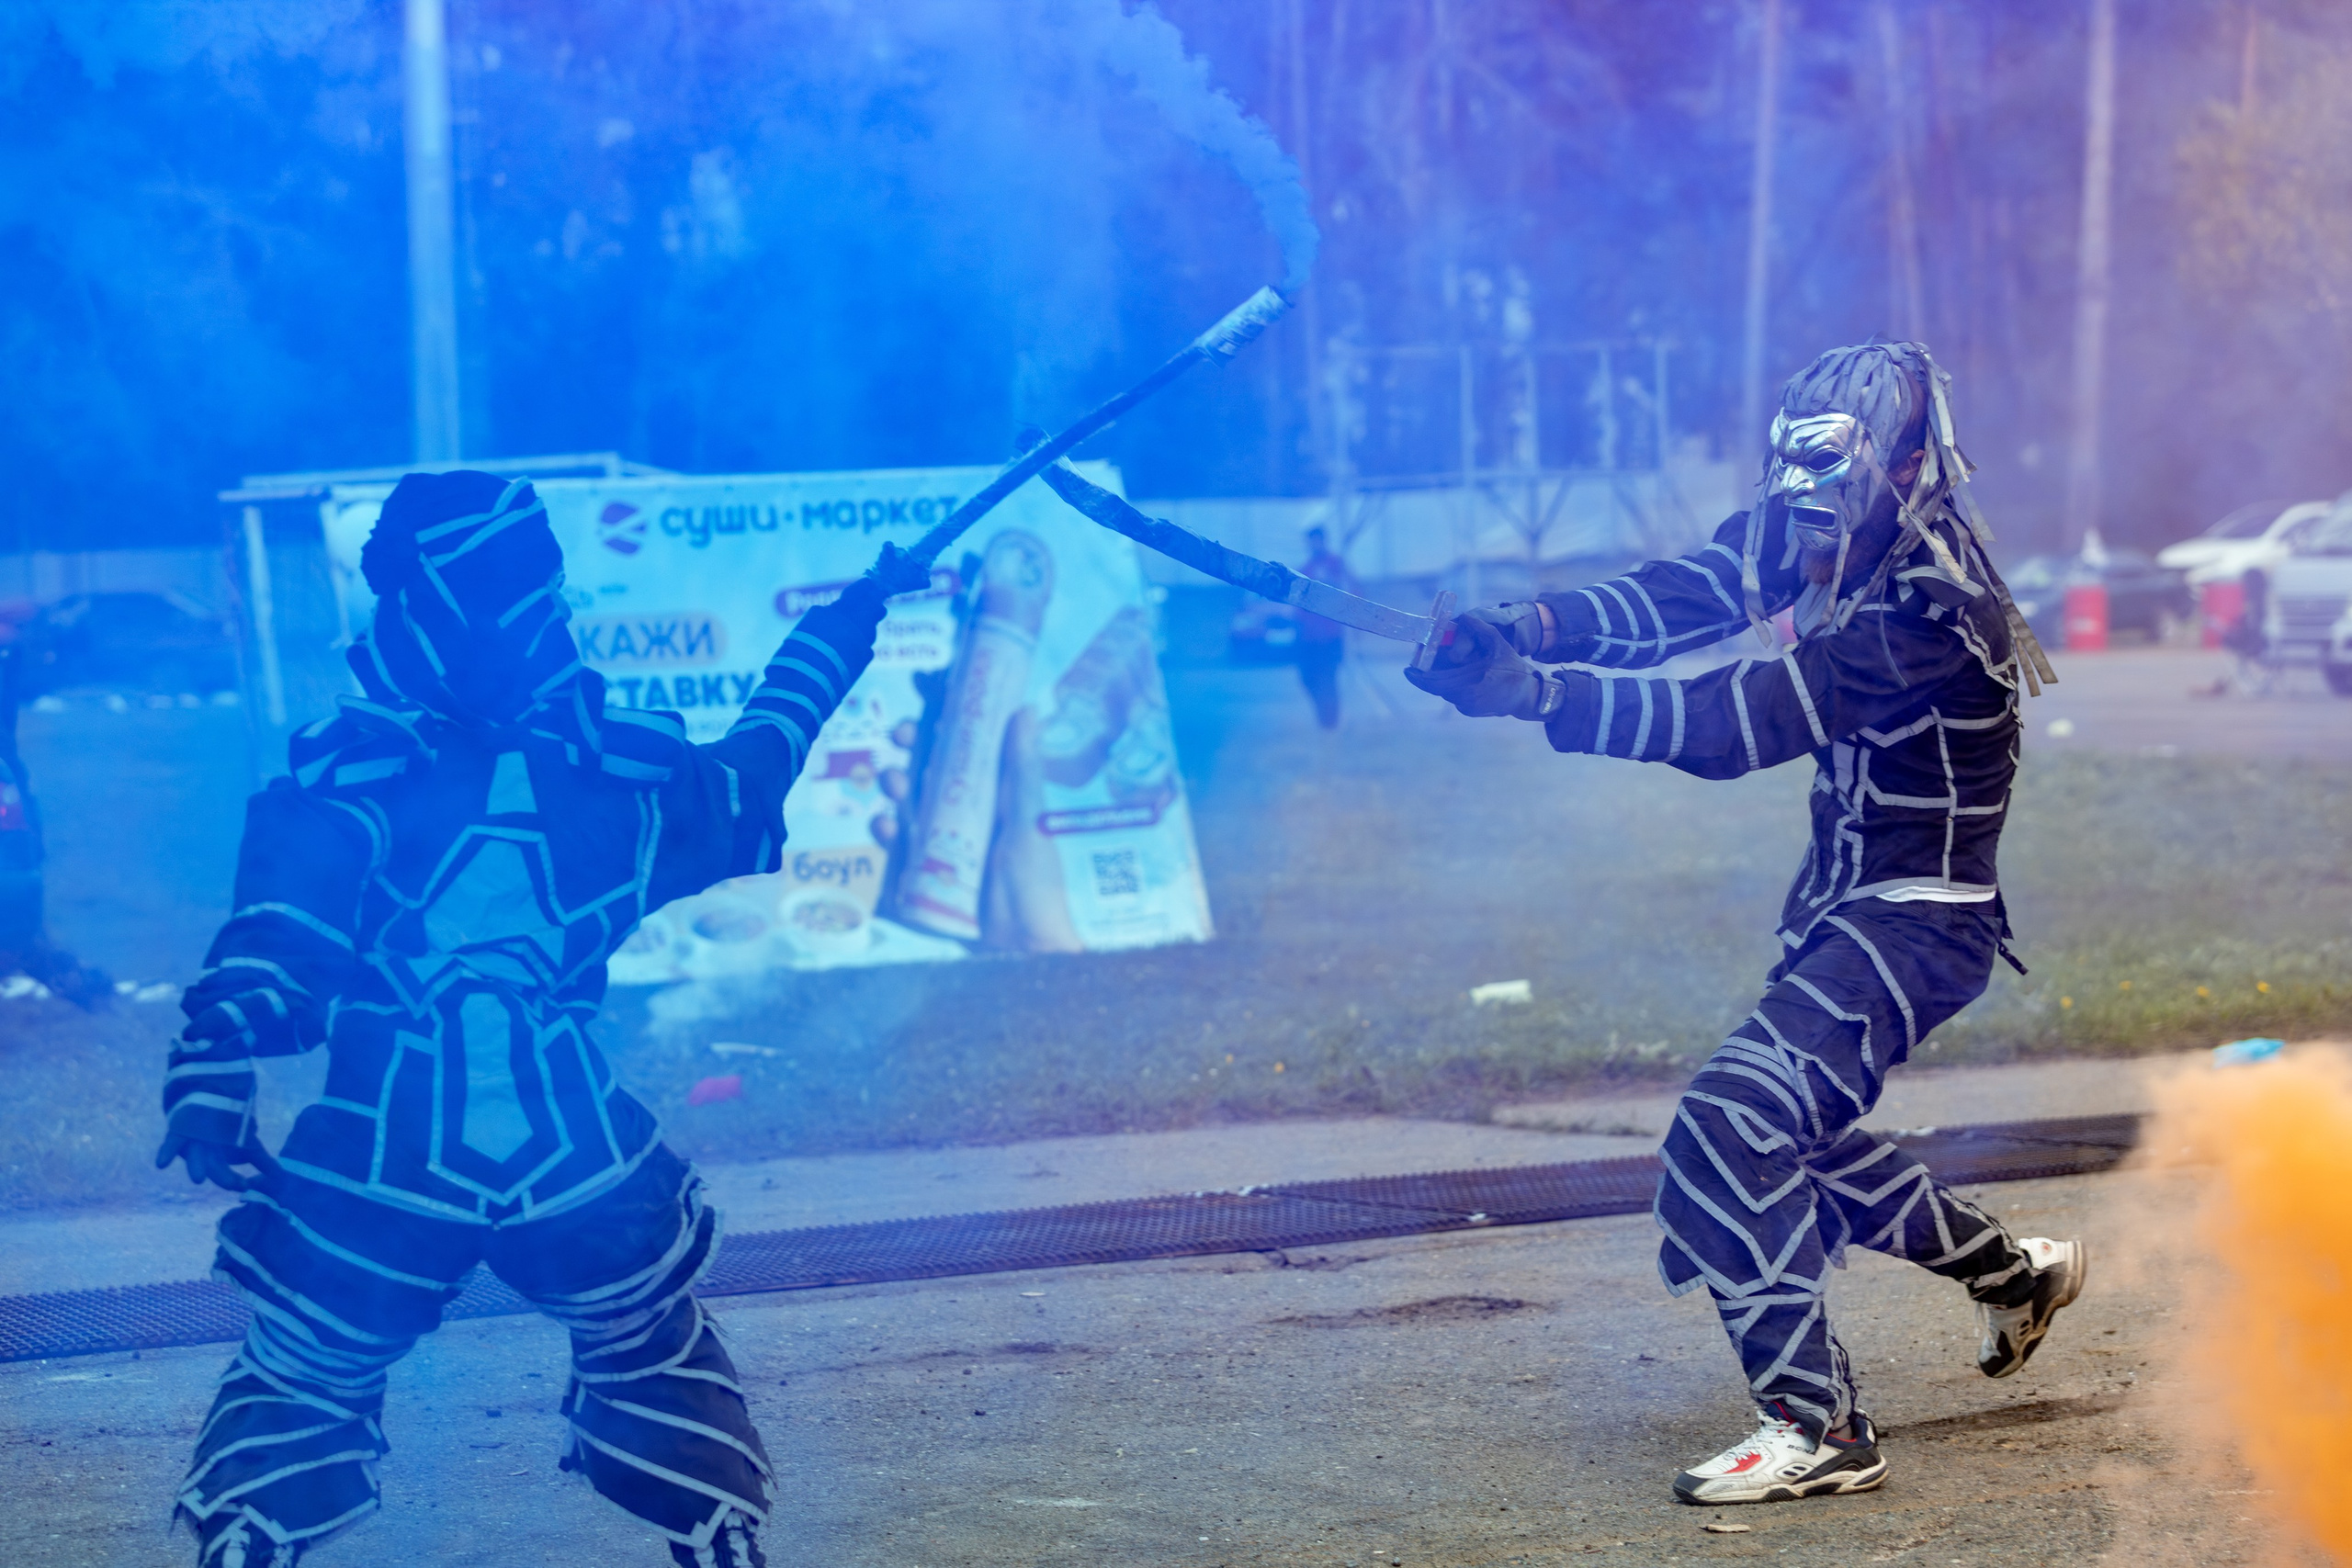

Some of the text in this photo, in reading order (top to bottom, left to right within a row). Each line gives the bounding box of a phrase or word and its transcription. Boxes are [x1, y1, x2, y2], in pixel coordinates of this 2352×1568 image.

[660, 496, 959, 548] суши маркет
[793, 851, 874, 888] боул
